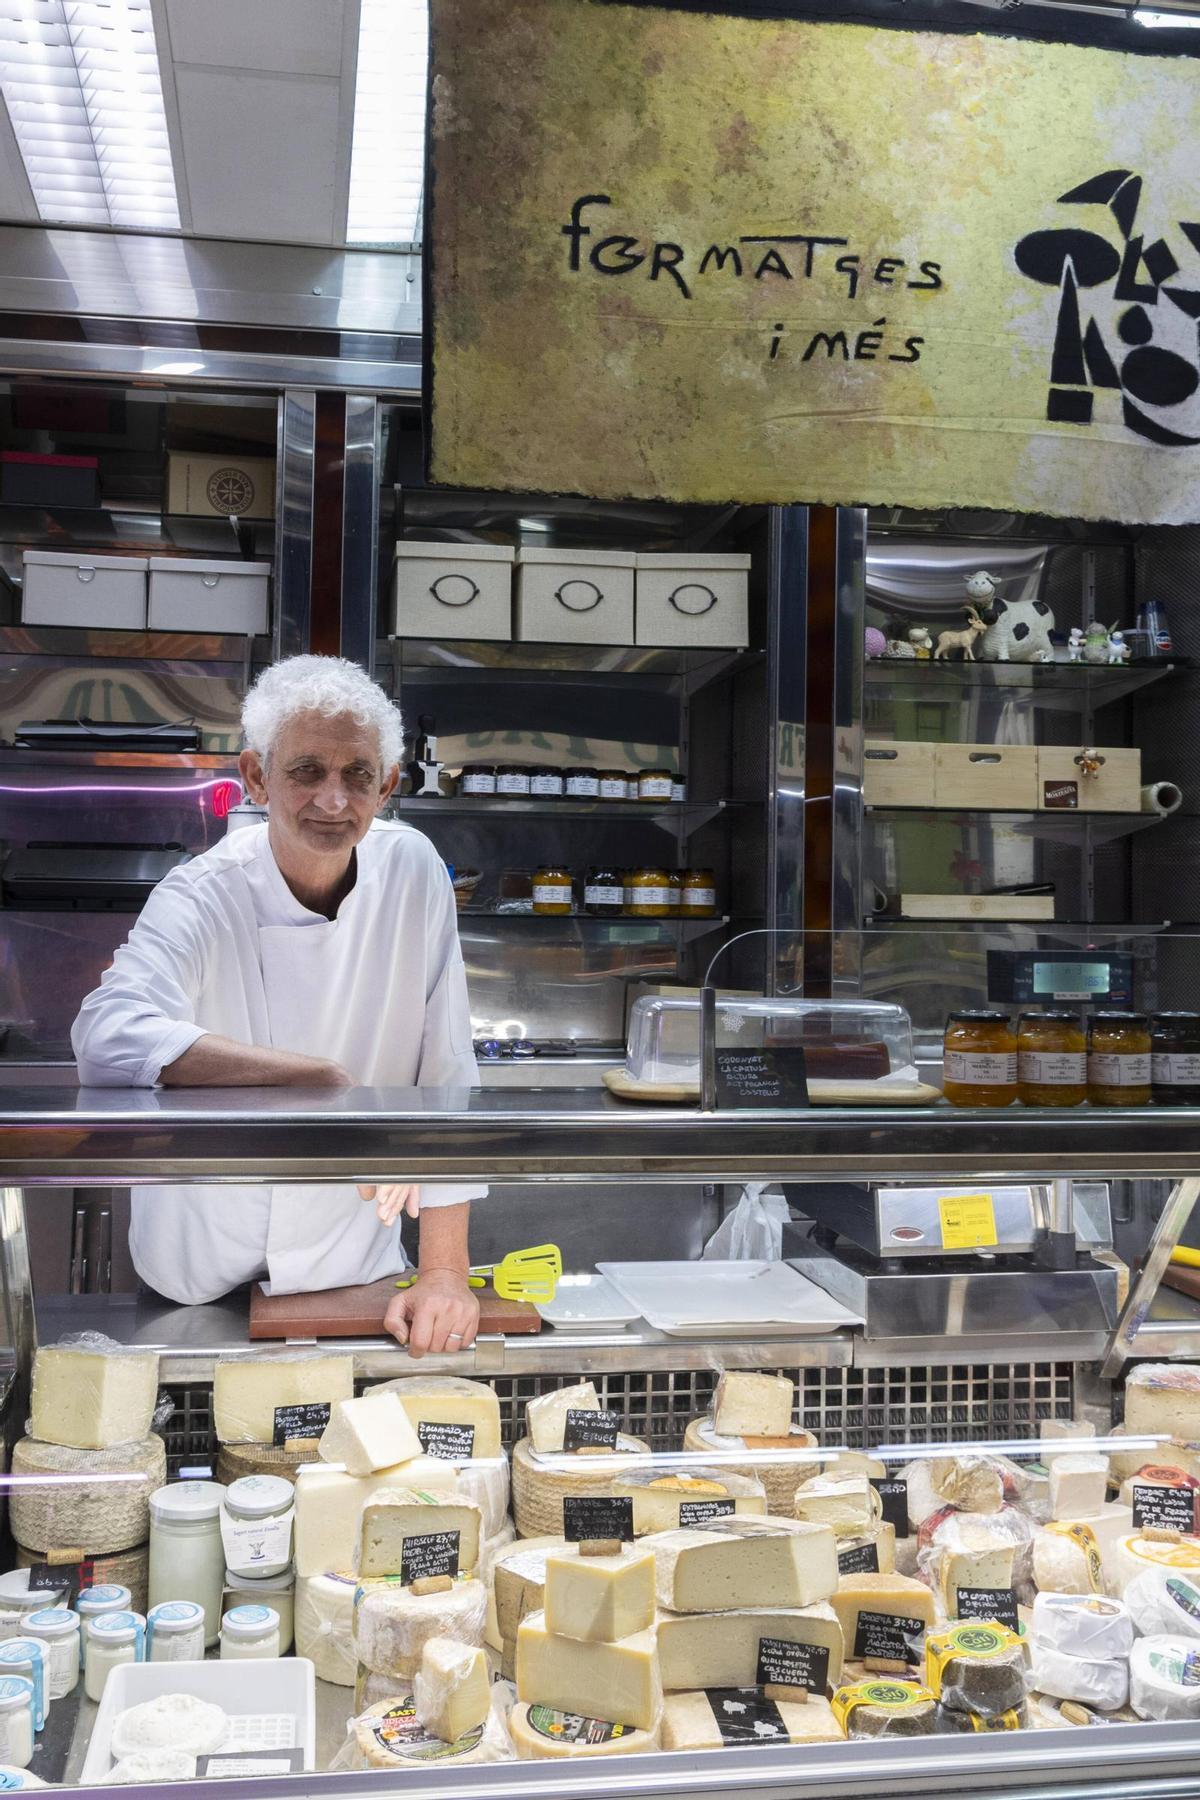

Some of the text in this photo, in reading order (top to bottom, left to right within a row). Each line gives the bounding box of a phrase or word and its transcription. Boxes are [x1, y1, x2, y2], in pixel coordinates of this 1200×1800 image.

[801, 316, 923, 364] MÉS
[769, 1672, 817, 1686] BADAJOZ
[388, 1708, 417, 1718] BAZT
